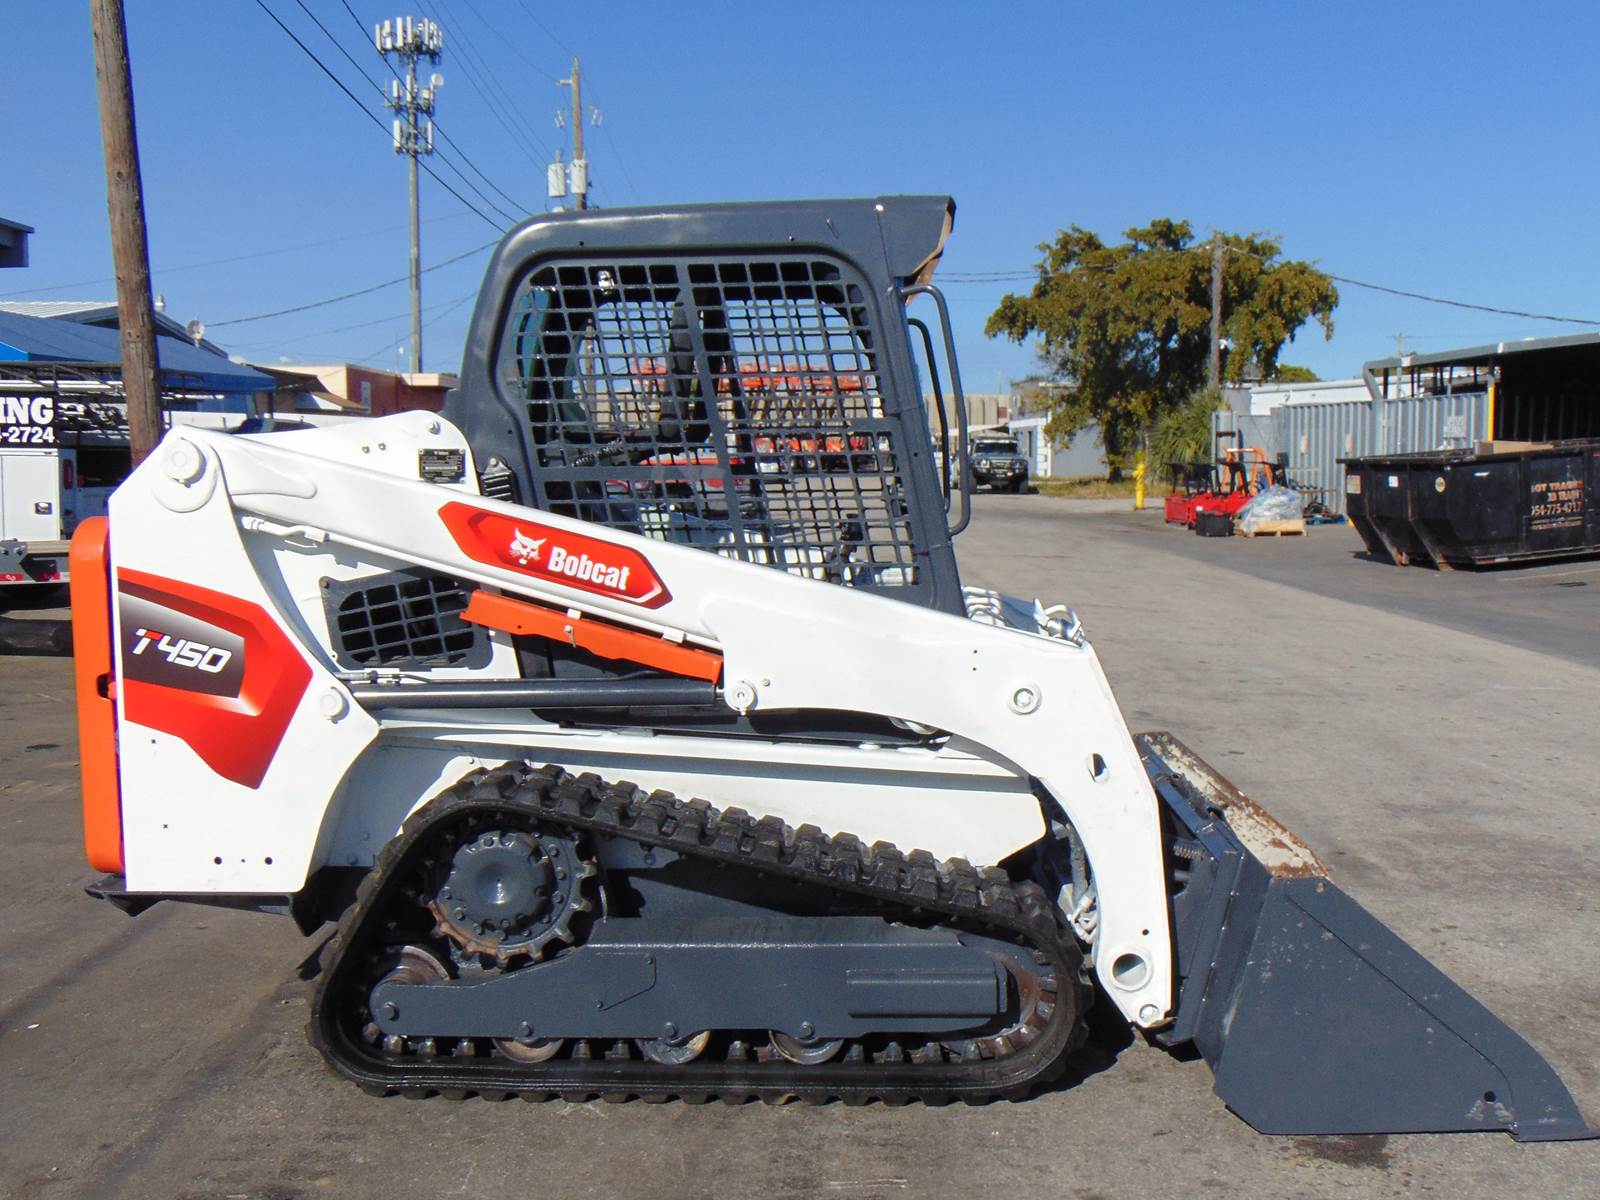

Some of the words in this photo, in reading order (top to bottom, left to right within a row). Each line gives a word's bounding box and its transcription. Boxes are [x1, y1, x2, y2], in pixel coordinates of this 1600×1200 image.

[0, 397, 54, 425] ING
[0, 426, 55, 443] -2724
[548, 546, 630, 591] Bobcat
[132, 628, 232, 673] T450
